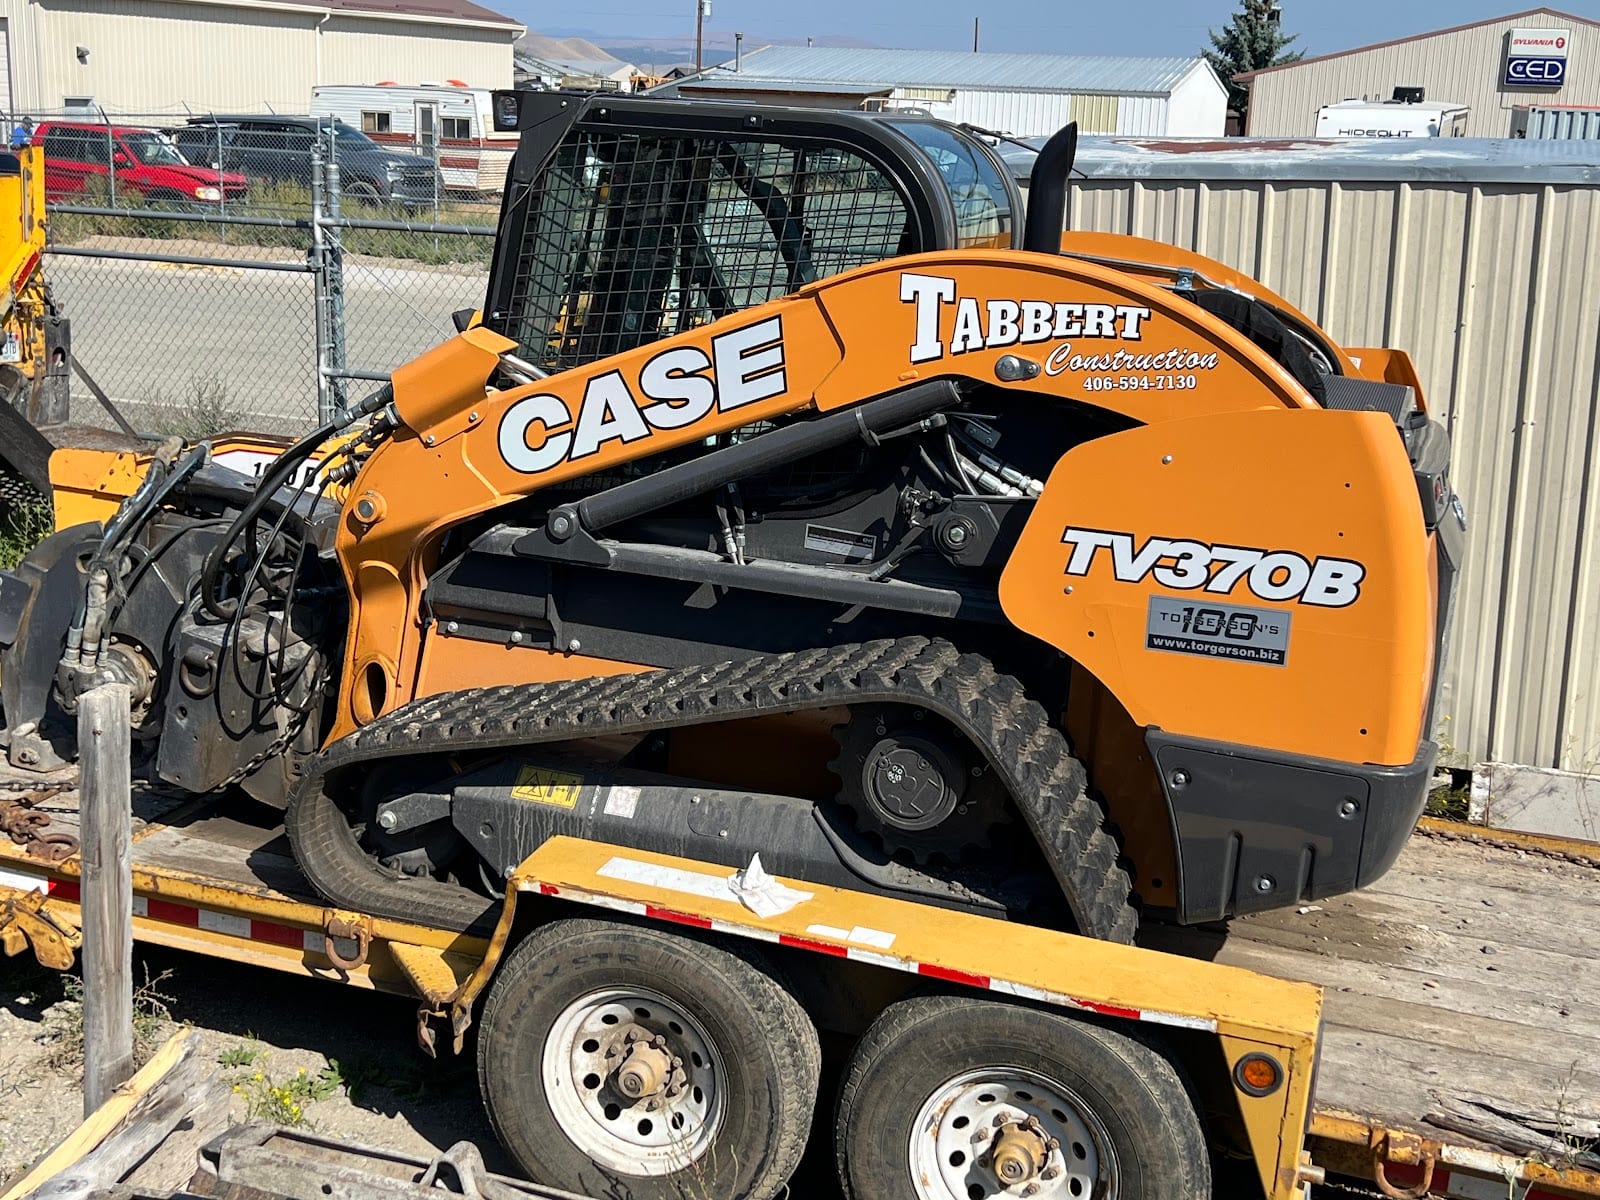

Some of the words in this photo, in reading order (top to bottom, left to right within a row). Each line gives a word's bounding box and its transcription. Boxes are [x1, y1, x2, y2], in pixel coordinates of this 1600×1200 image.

[1512, 38, 1554, 46] SYLVANIA
[1508, 59, 1563, 79] CED
[1338, 128, 1413, 138] HIDEOUT
[899, 272, 1151, 364] TABBERT
[1044, 341, 1219, 377] Construction
[498, 314, 788, 474] CASE
[1083, 374, 1197, 391] 406-594-7130
[1060, 526, 1367, 608] TV370B
[1159, 611, 1280, 635] TORGERSON'S
[1153, 638, 1280, 661] www.torgerson.biz
